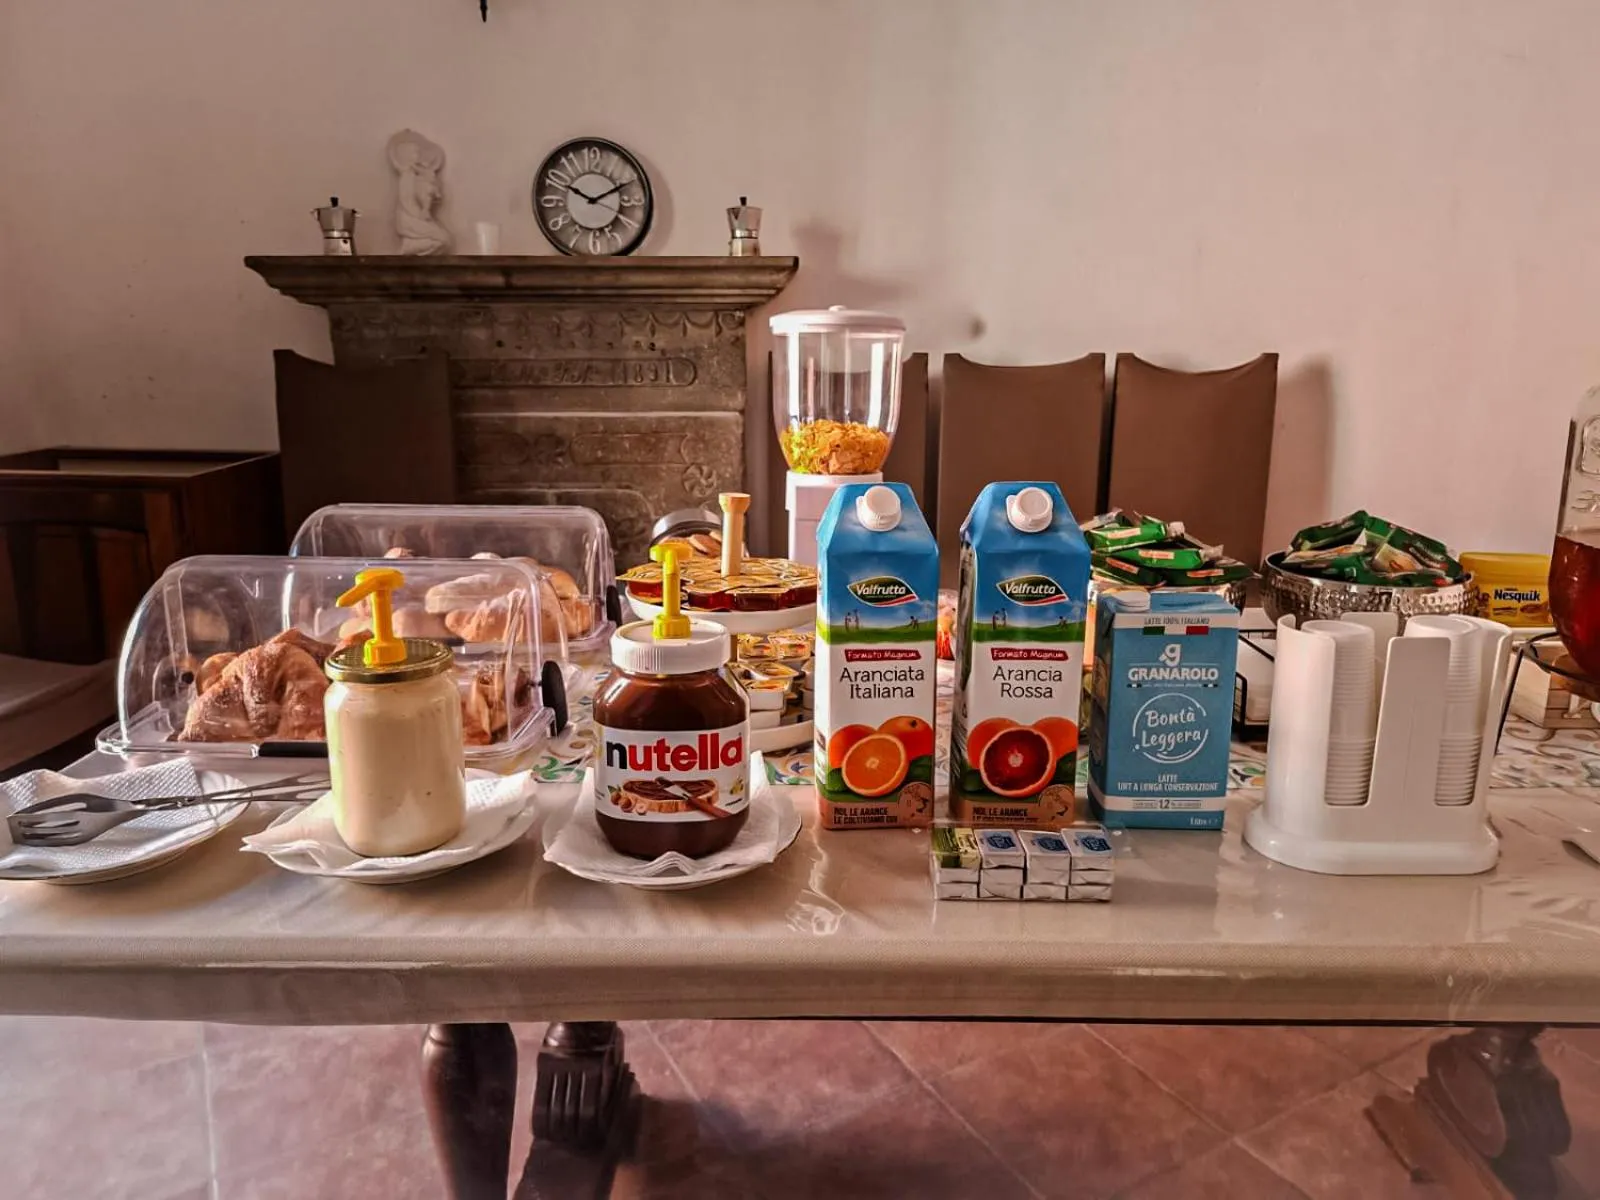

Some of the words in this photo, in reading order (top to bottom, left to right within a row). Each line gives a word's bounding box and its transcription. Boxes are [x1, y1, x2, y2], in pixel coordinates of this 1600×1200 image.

[560, 152, 584, 178] 11
[581, 147, 601, 173] 12
[545, 169, 572, 192] 10
[541, 195, 565, 208] 9
[620, 196, 645, 207] 3
[548, 213, 572, 231] 8
[569, 225, 582, 249] 7
[588, 230, 601, 256] 6
[855, 582, 907, 596] Valfrutta
[1004, 581, 1057, 596] Valfrutta
[1493, 588, 1541, 603] Nesquik
[847, 651, 882, 659] Formato
[883, 651, 917, 660] Magnum
[993, 650, 1028, 659] Formato
[1030, 650, 1064, 660] Magnum
[840, 665, 925, 682] Aranciata
[992, 665, 1063, 682] Arancia
[1127, 667, 1219, 681] GRANAROLO
[850, 684, 915, 699] Italiana
[1000, 683, 1053, 699] Rossa
[1145, 706, 1196, 728] Bontà
[1141, 730, 1202, 752] Leggera
[605, 733, 743, 772] nutella
[1157, 774, 1178, 783] LATTE
[1164, 782, 1219, 792] CONSERVAZIONE
